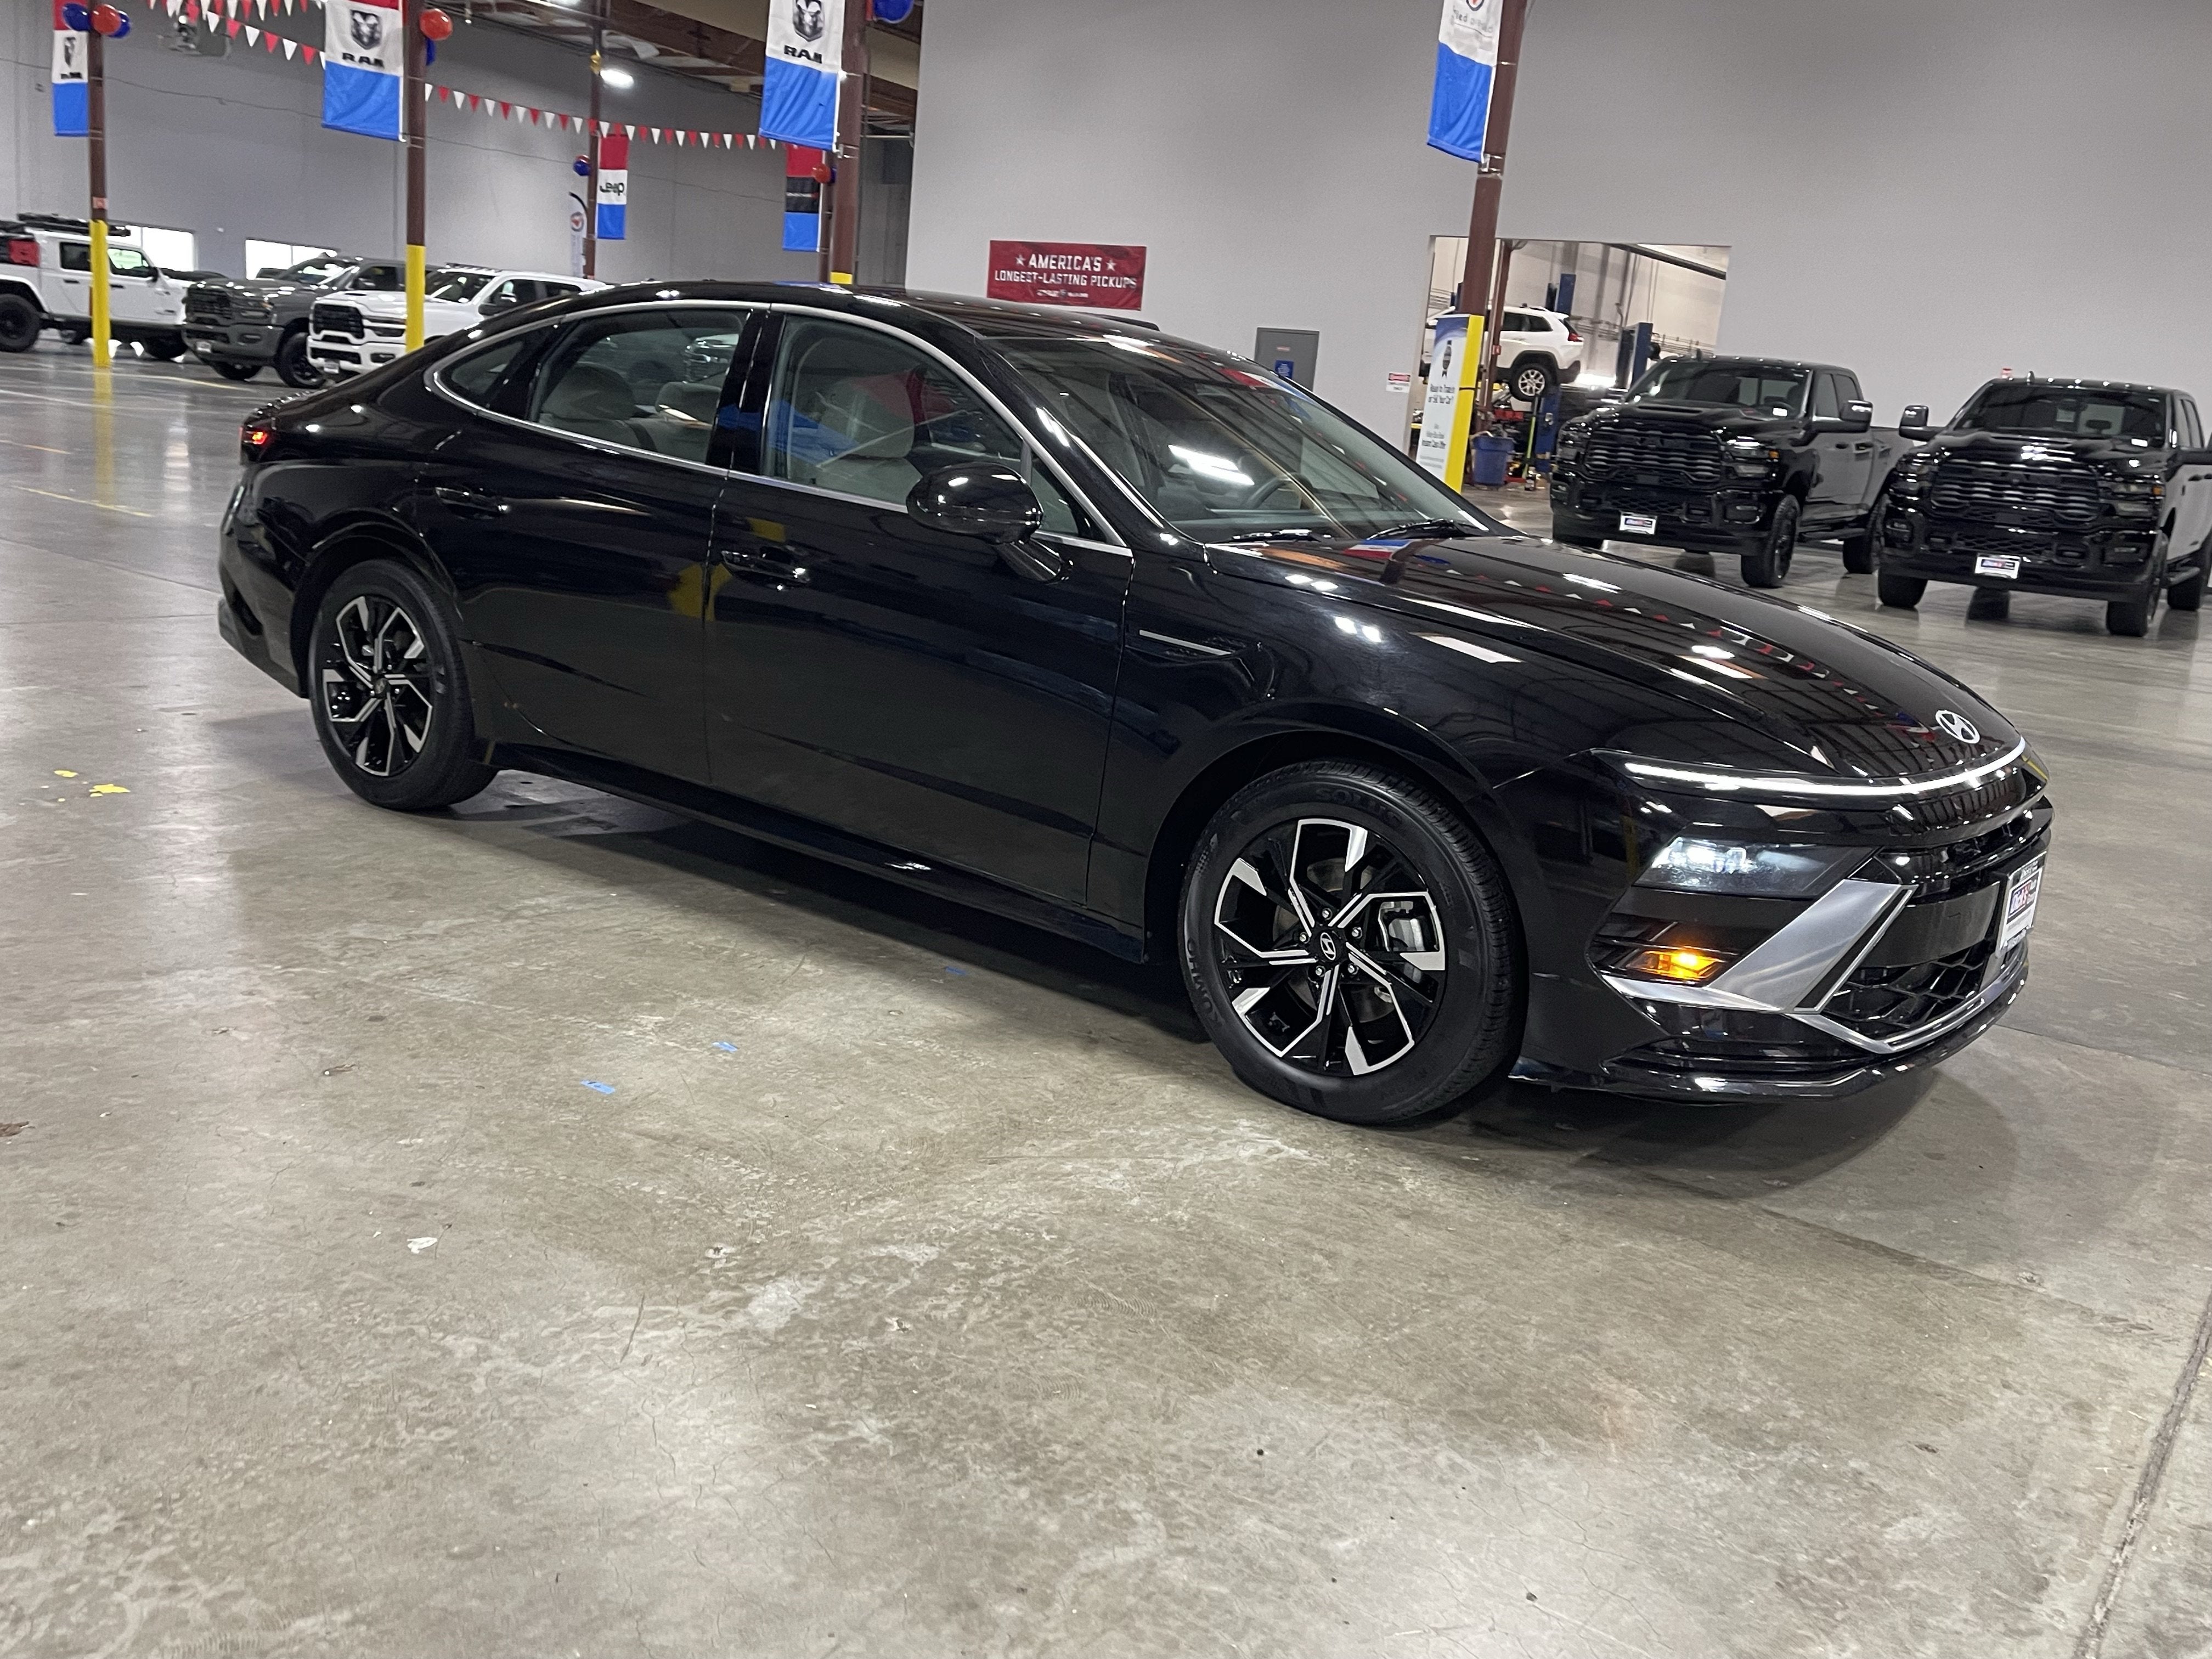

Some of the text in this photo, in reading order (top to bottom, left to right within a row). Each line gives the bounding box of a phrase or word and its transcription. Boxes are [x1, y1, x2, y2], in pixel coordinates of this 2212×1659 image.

[1029, 253, 1103, 272] AMERICA'S
[994, 269, 1137, 289] LONGEST-LASTING PICKUPS
